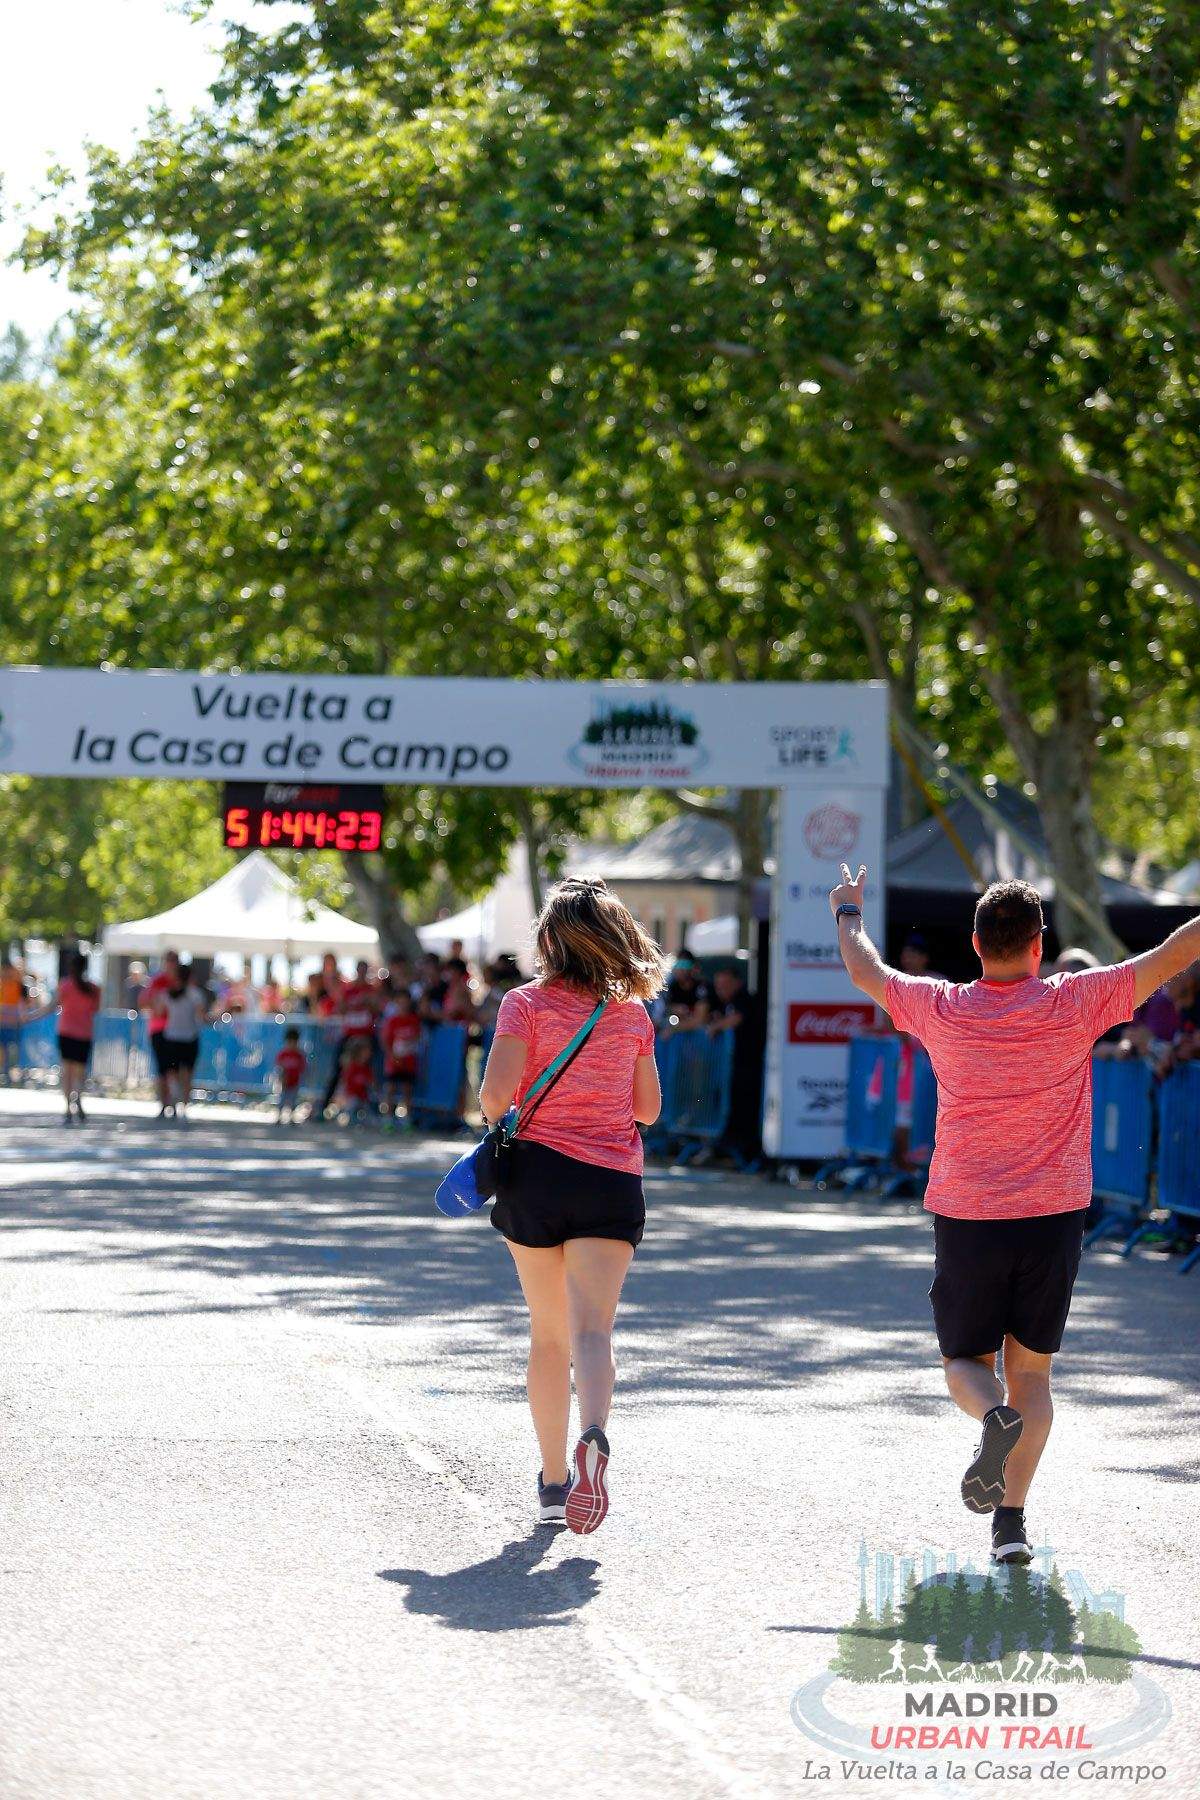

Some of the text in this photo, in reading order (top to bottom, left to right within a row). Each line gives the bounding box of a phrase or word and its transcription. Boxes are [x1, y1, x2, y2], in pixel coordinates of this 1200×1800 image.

[192, 684, 394, 723] Vuelta a
[72, 726, 510, 779] la Casa de Campo
[778, 747, 827, 766] LIFE
[786, 939, 839, 959] Iber
